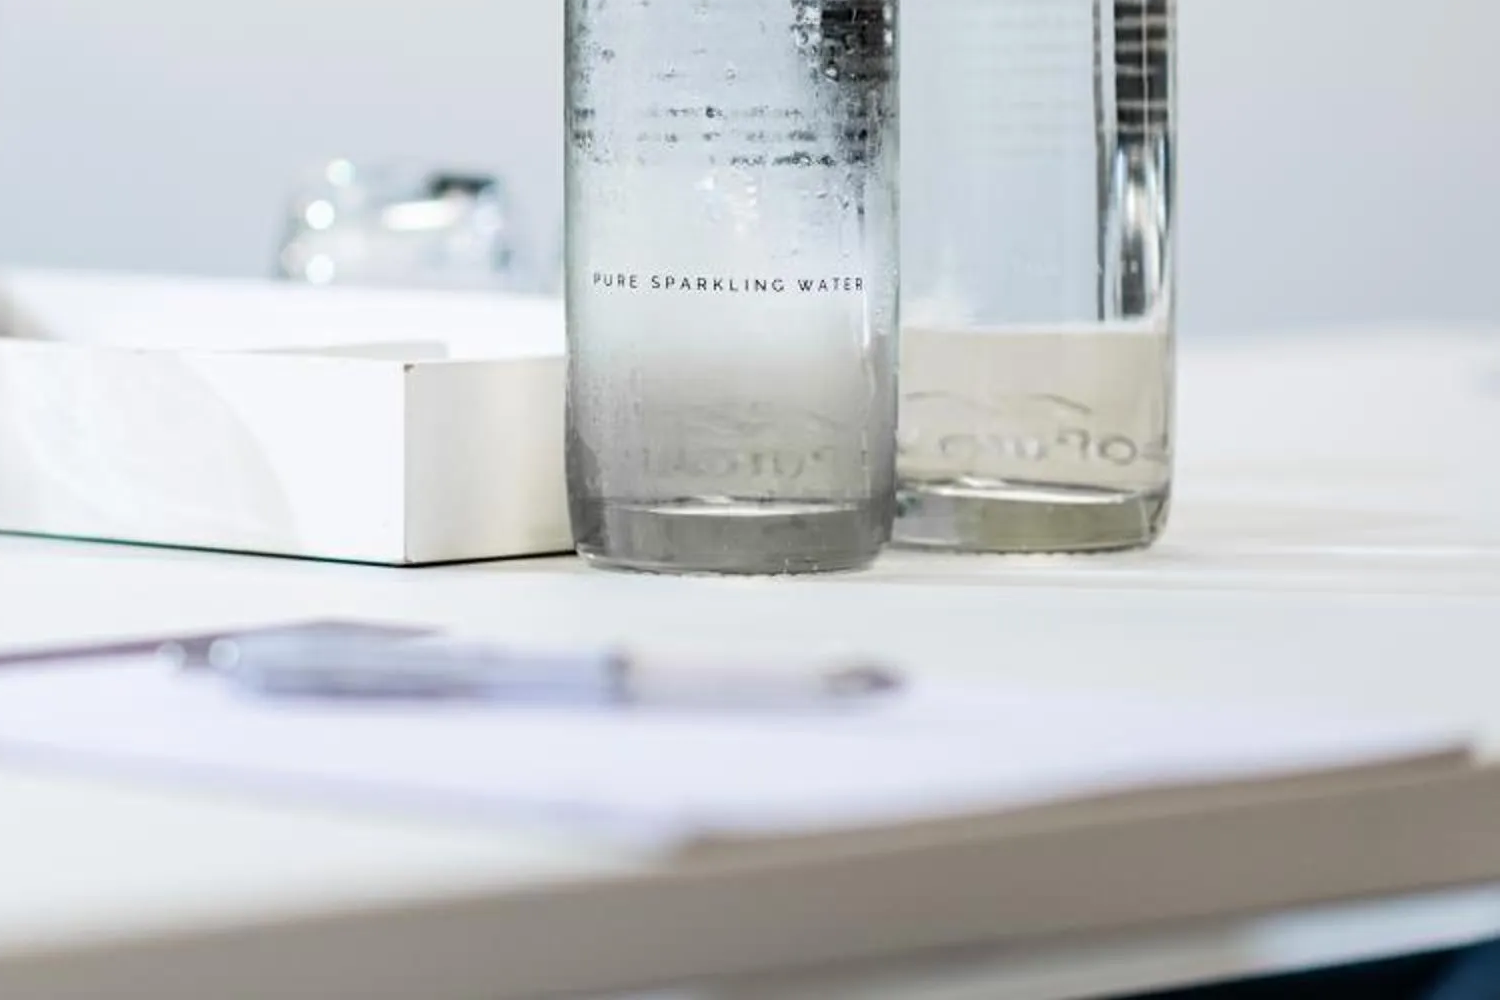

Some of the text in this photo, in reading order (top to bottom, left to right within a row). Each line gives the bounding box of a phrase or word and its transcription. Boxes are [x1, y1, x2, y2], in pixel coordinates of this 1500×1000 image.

[593, 272, 864, 293] PURE SPARKLING WATER
